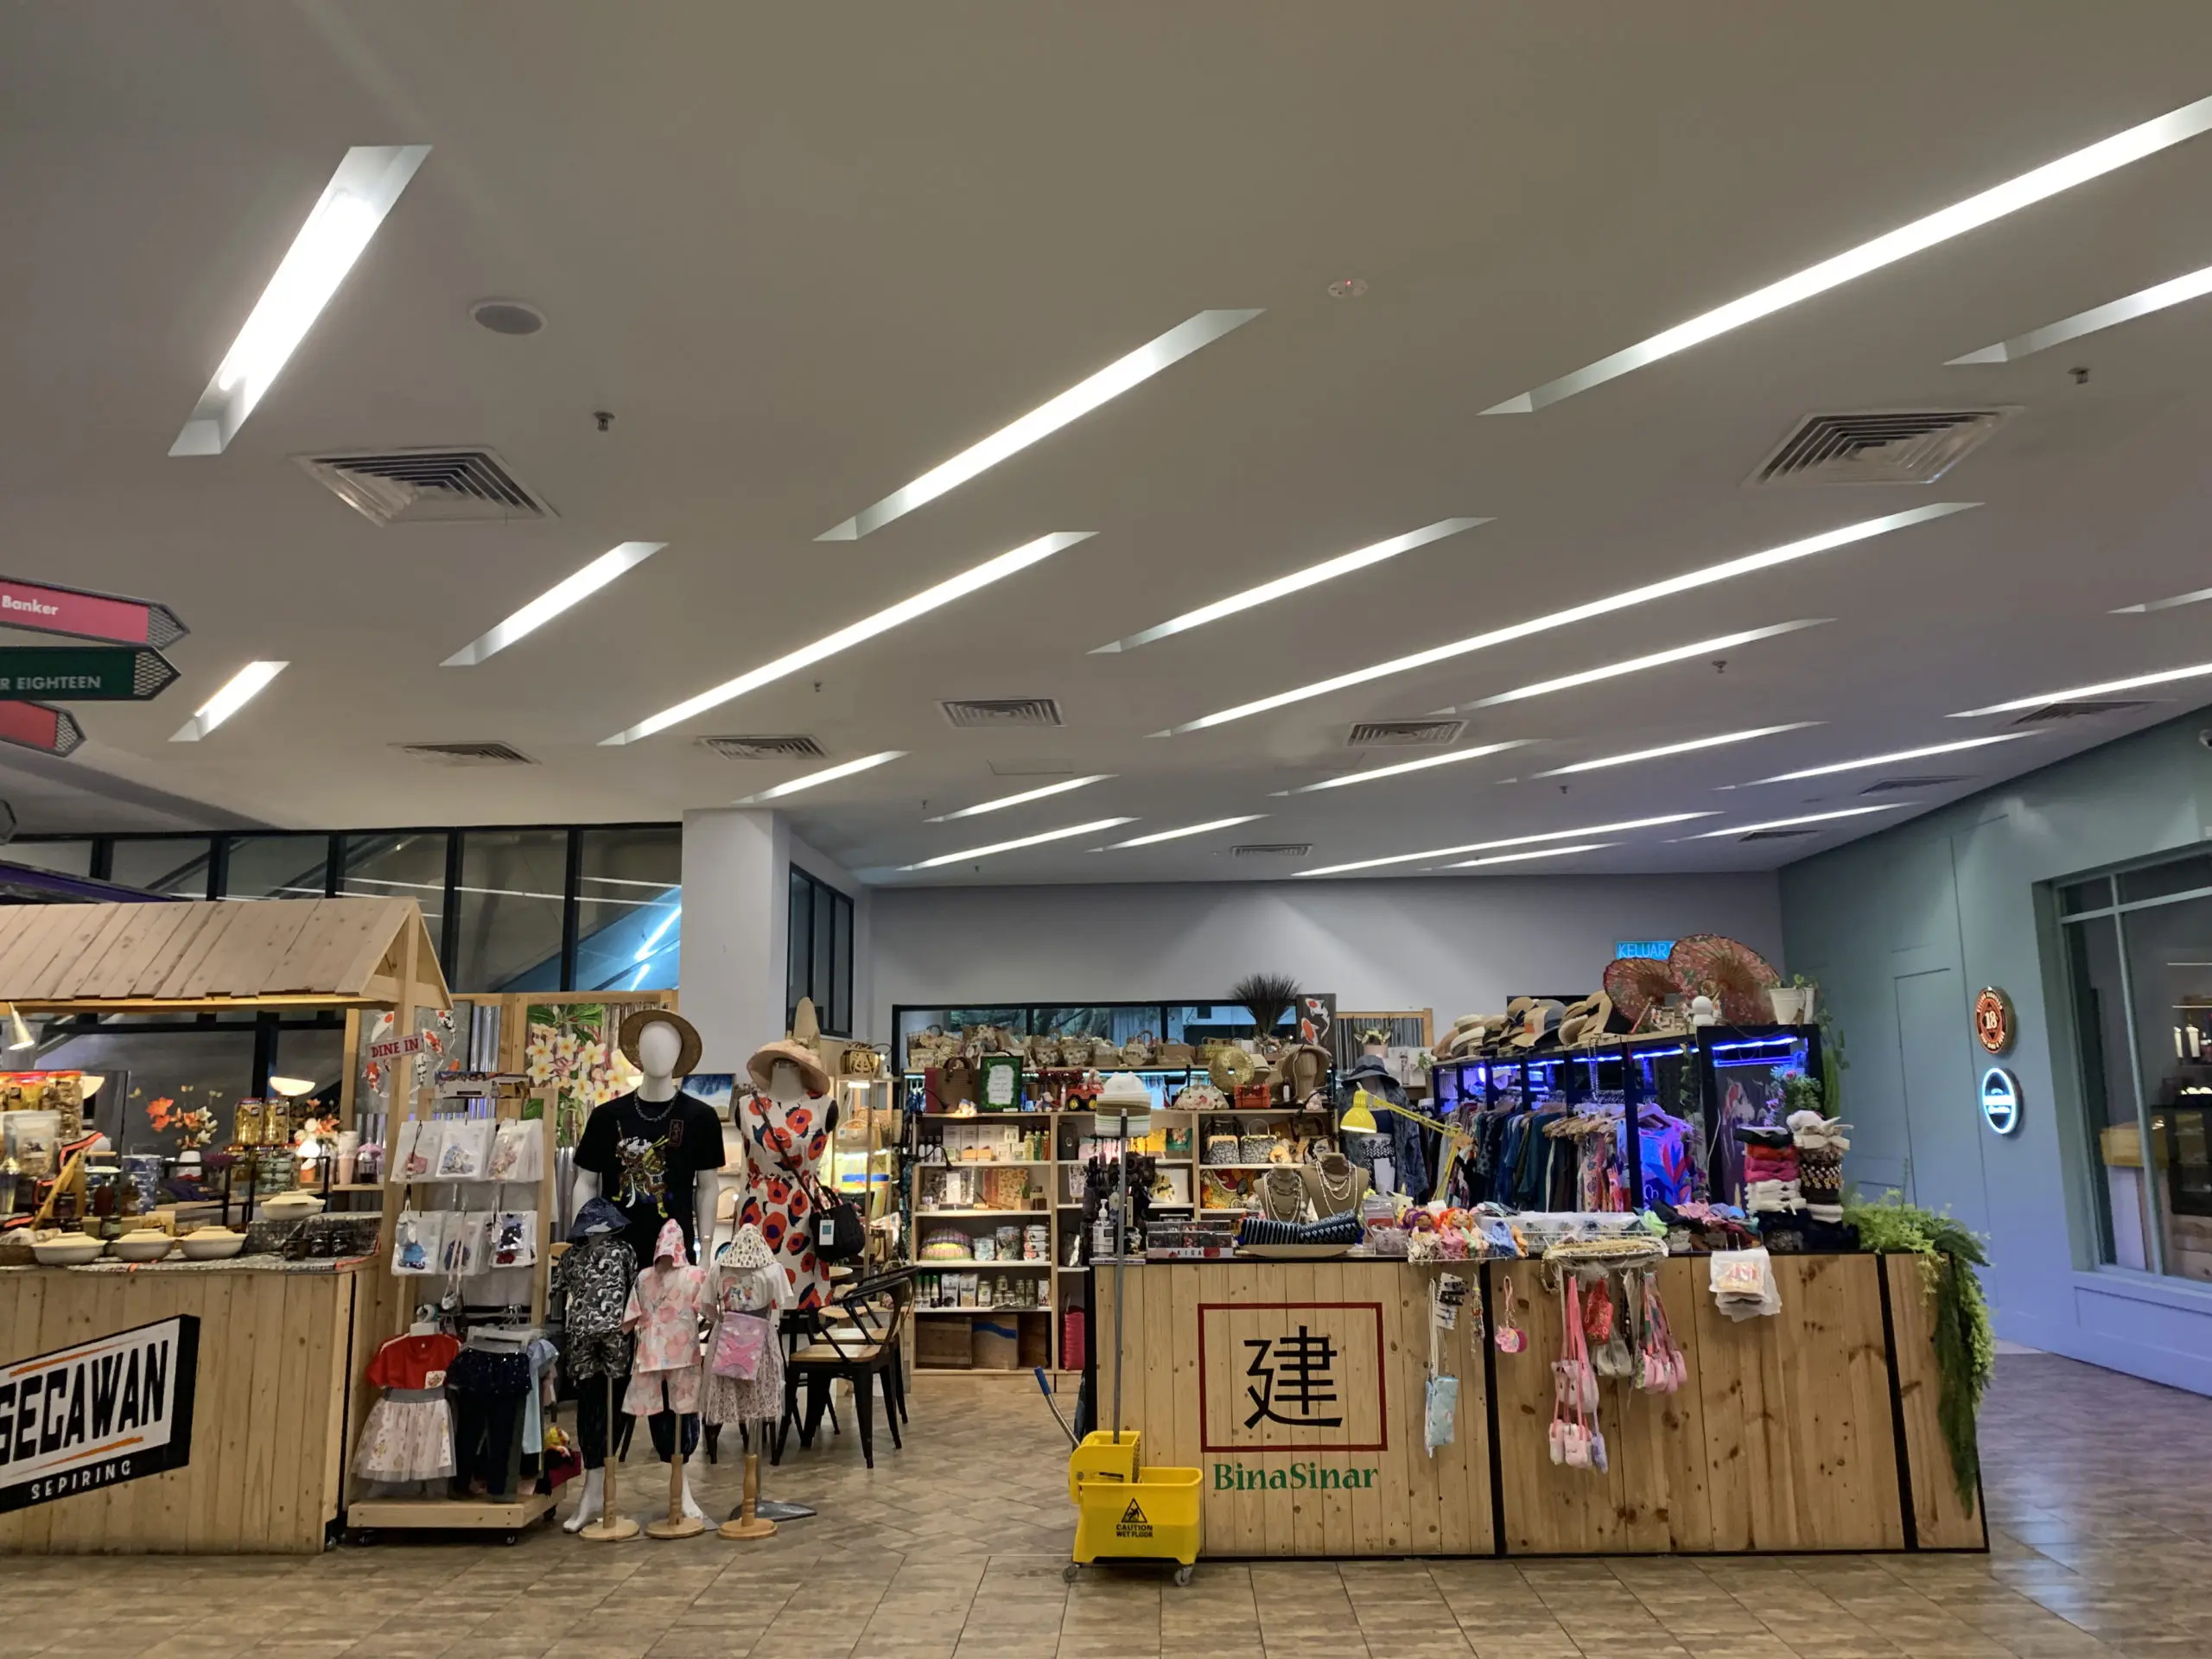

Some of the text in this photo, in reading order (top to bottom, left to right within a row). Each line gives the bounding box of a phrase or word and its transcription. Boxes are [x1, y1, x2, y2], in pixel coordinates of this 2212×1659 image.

[2, 594, 59, 616] Banker
[17, 676, 101, 690] EIGHTEEN
[1618, 943, 1667, 959] KELUAR
[1984, 1010, 1998, 1029] 18
[372, 1038, 419, 1058] DINE IN
[1243, 1325, 1344, 1430] 建
[0, 1338, 169, 1466] SECAWAN
[30, 1459, 131, 1500] SEPIRING
[1213, 1461, 1379, 1491] BinaSinar
